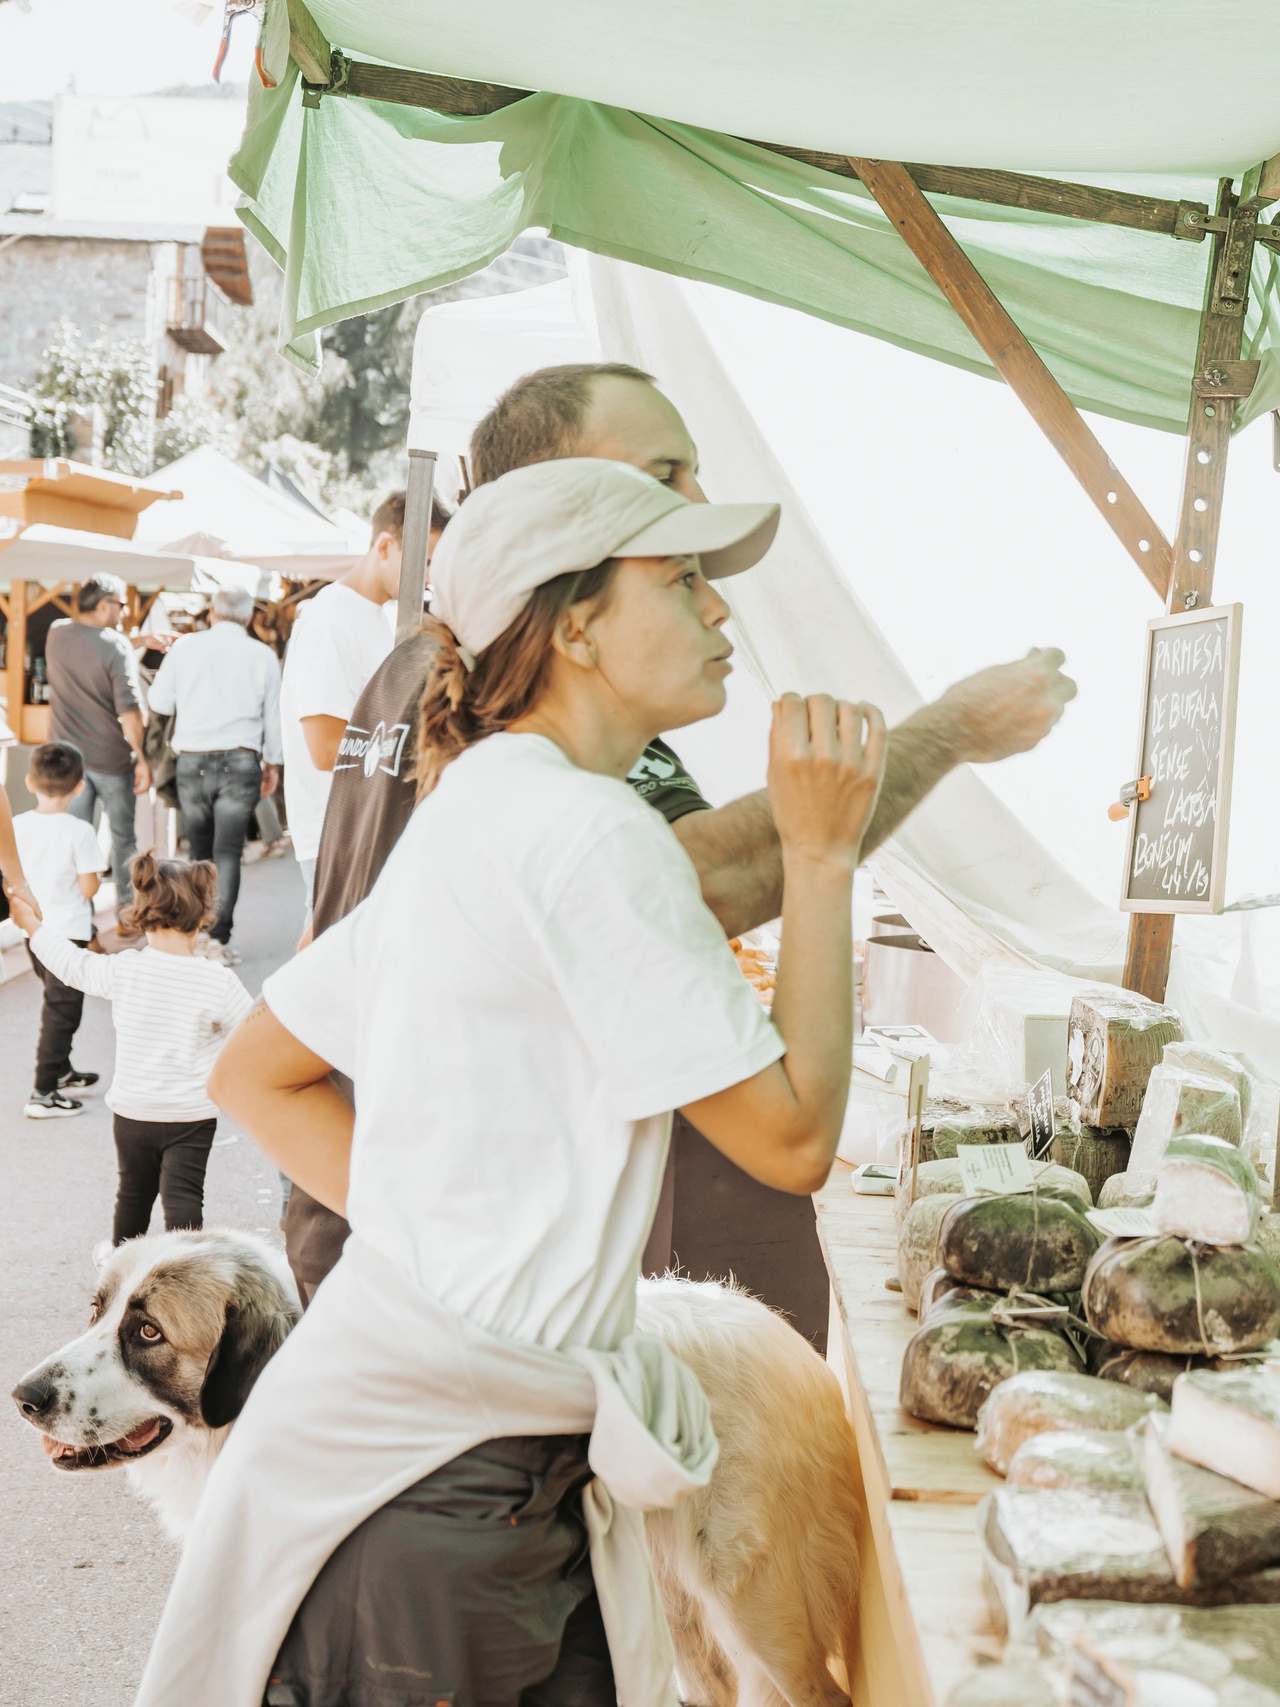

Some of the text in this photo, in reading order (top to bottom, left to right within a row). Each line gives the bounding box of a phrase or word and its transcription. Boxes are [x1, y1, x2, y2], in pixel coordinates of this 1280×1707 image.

[1151, 683, 1219, 738] DE BUFALA
[1150, 740, 1194, 790] SENSE
[1164, 786, 1217, 829] LACTOSA
